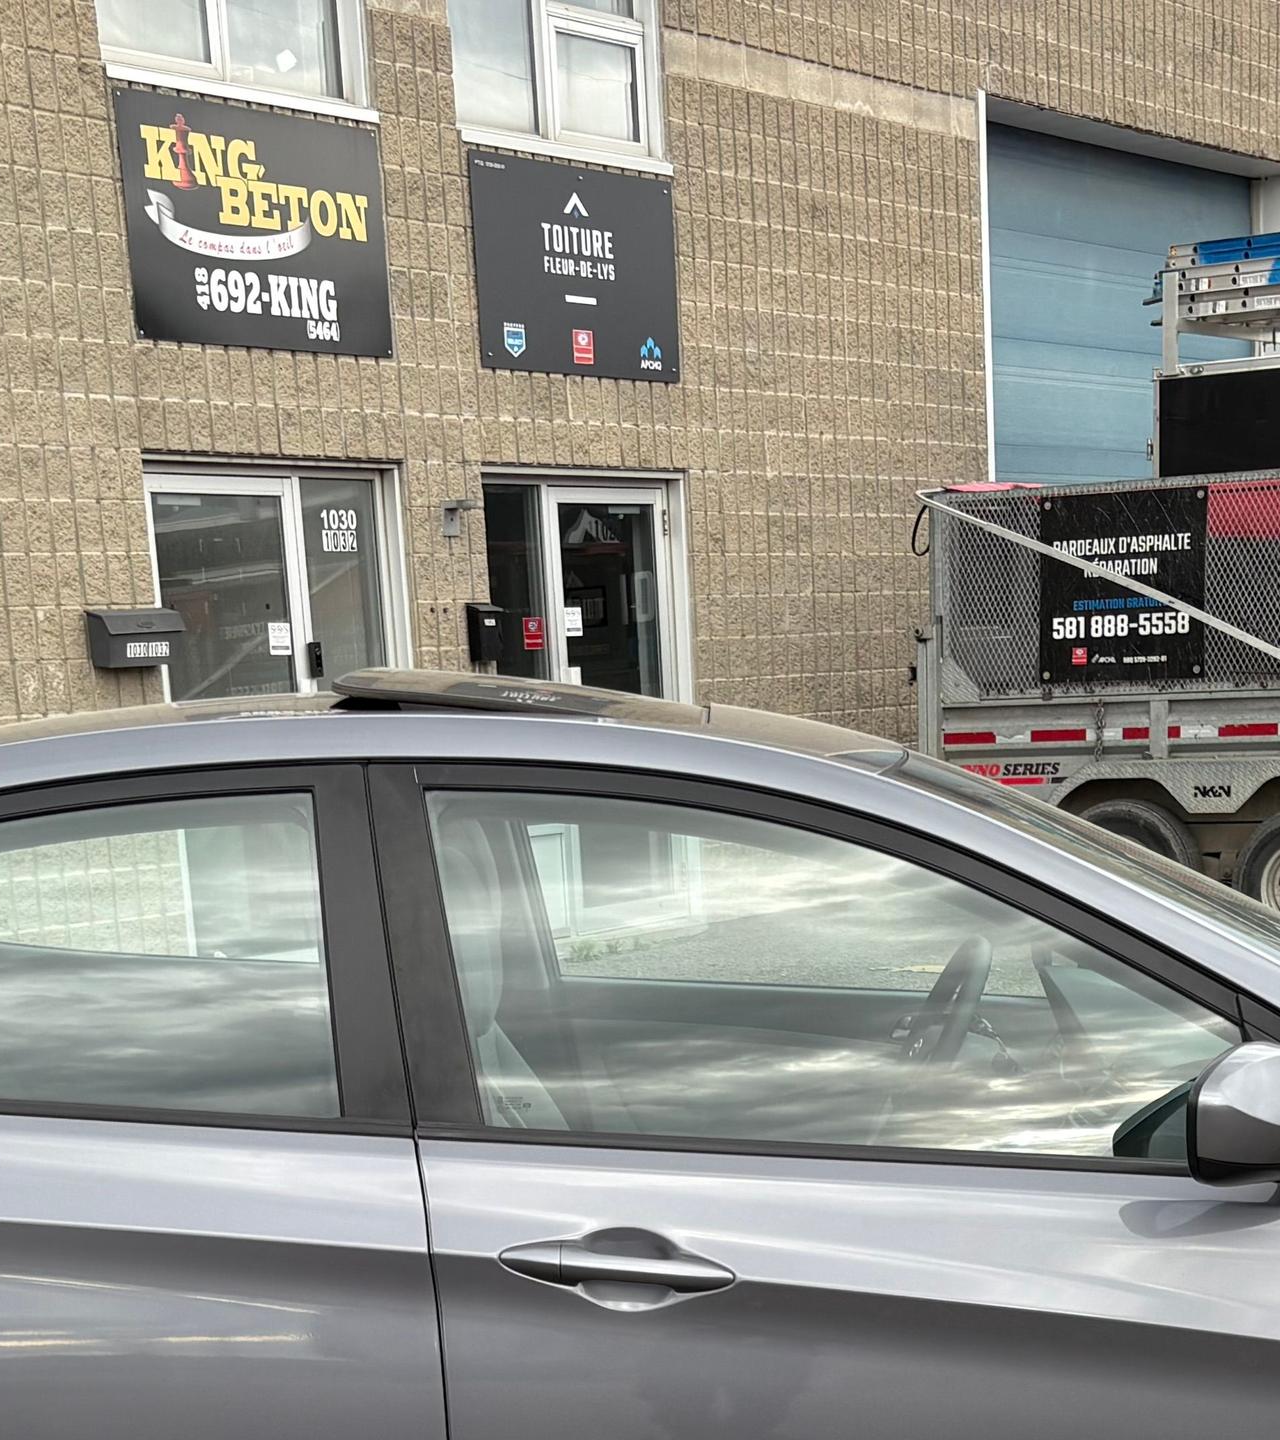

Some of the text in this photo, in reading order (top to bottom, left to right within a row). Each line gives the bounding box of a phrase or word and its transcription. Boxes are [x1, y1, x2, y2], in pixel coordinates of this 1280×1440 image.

[139, 122, 266, 190] KING
[541, 222, 614, 260] TOITURE
[543, 255, 616, 281] FLEUR-DE-LYS
[194, 267, 338, 321] 418 692-KING
[306, 319, 341, 342] (5464)
[320, 508, 357, 530] 1030
[323, 530, 357, 551] 1032
[1119, 532, 1192, 555] D'ASPHALTE
[1073, 598, 1124, 611] ESTIMATION
[1052, 611, 1190, 640] 581 888-5558
[1002, 762, 1060, 776] SERIES
